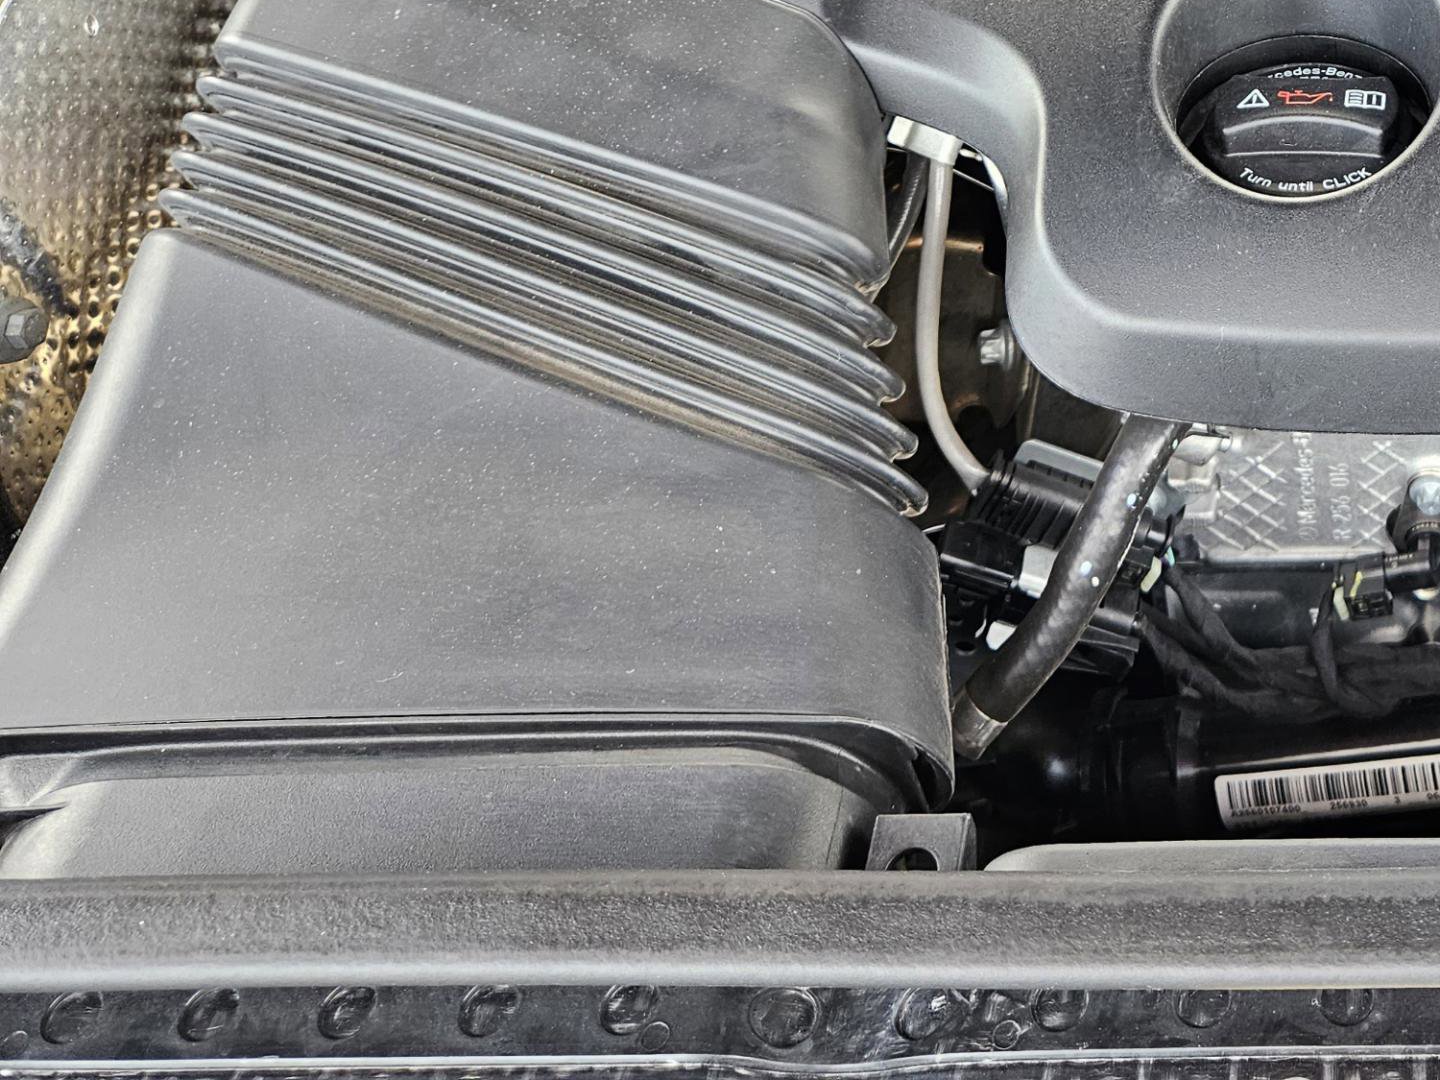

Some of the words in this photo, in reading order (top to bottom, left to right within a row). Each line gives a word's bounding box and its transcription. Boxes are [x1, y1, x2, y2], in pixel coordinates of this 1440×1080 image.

[1240, 168, 1272, 189] Turn
[1278, 180, 1314, 193] until
[1322, 167, 1372, 191] CLICK
[1327, 463, 1350, 487] 016
[1329, 495, 1353, 522] 256
[1331, 528, 1353, 540] R
